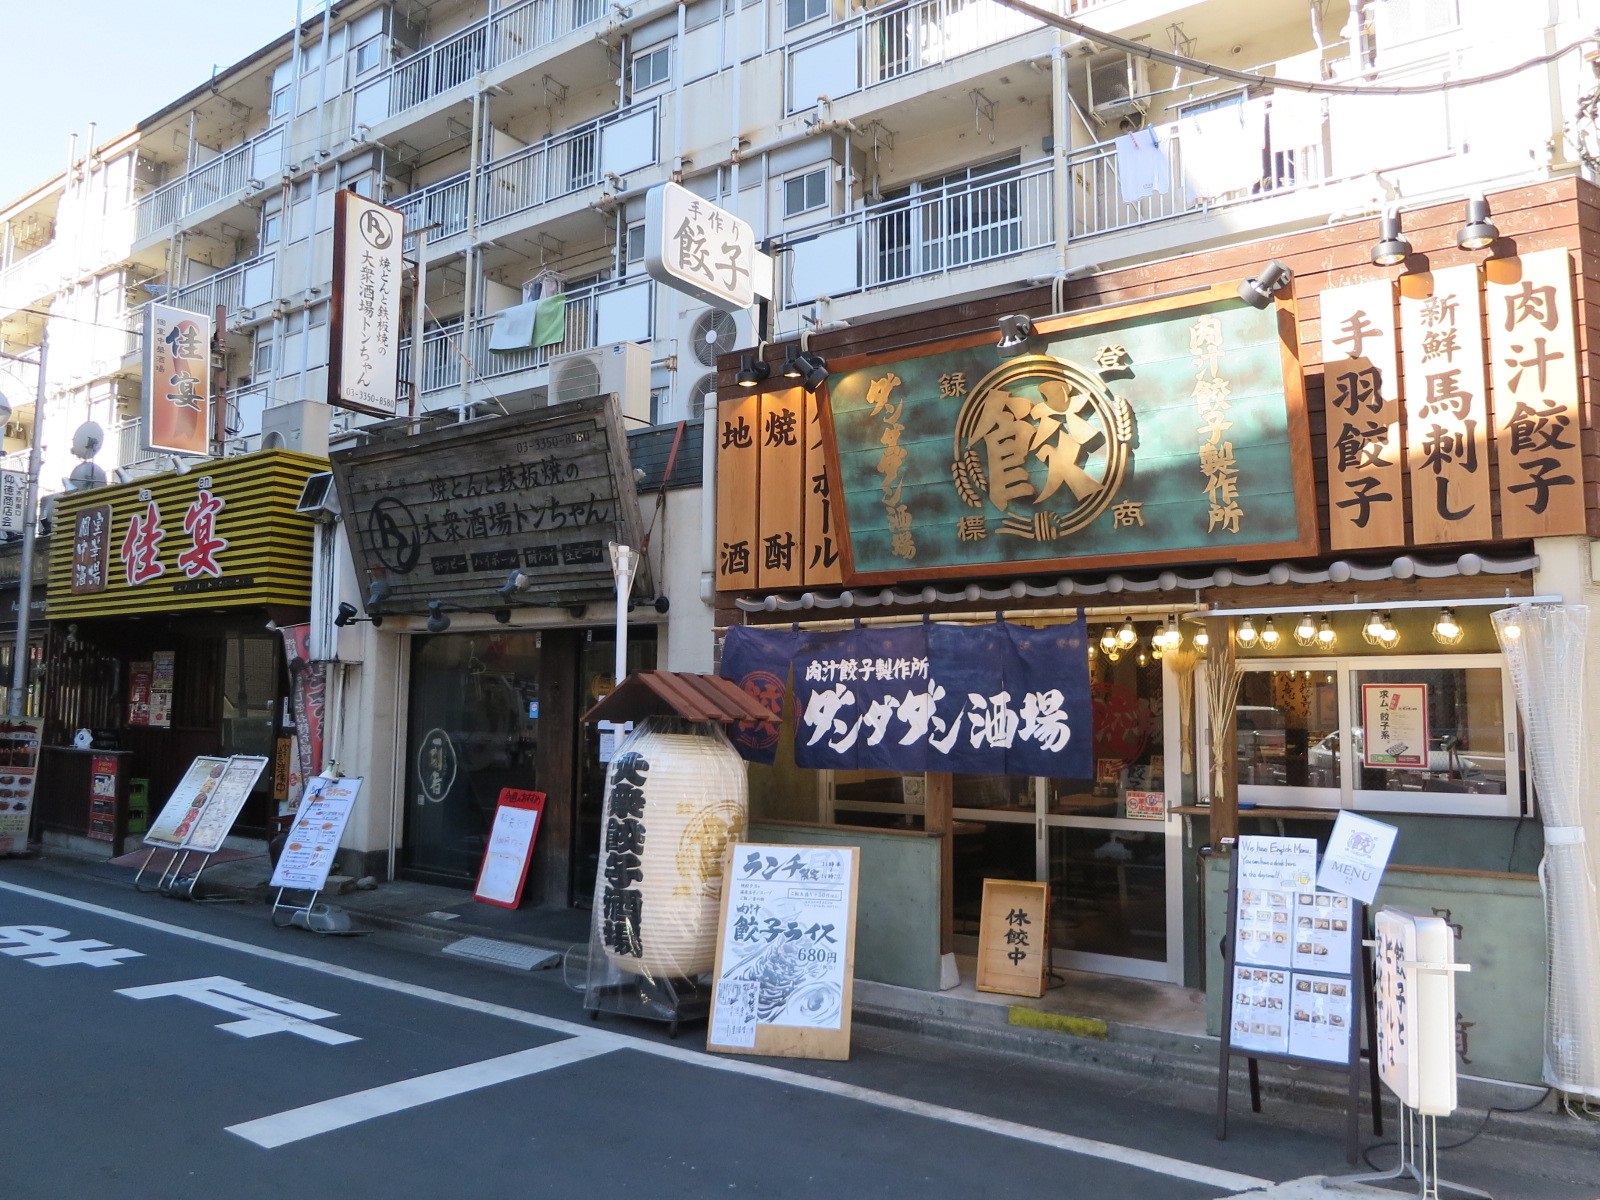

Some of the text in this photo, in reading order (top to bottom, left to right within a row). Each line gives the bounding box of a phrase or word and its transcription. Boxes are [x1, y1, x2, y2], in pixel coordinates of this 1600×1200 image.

[688, 201, 741, 242] 手作り
[673, 216, 750, 291] 餃子
[357, 250, 376, 388] 大衆酒場トンちゃん
[376, 255, 392, 357] 焼とんと鉄板焼の
[166, 325, 205, 412] 佳宴
[938, 372, 968, 400] 録
[1092, 345, 1130, 373] 登
[345, 387, 395, 409] 03-3350-8580
[1188, 314, 1245, 534] 肉汁餃子製作所
[1332, 310, 1393, 528] 手羽餃子
[1418, 293, 1478, 521] 新鮮馬刺し
[1503, 281, 1576, 514] 肉汁餃子
[516, 429, 591, 454] 03-3350-8580
[866, 373, 917, 560] ダンダダン酒場
[966, 380, 1104, 512] 餃
[199, 477, 211, 488] en
[428, 455, 580, 502] 焼とんと鉄板焼の
[721, 416, 753, 576] 地酒
[763, 408, 798, 572] 焼酎
[121, 490, 229, 586] 佳宴
[420, 493, 609, 546] 大衆酒場トンちゃん
[956, 515, 988, 541] 標
[1111, 500, 1146, 529] 商
[805, 656, 930, 682] 肉汁餃子製作所
[803, 678, 1072, 754] ダンダダン酒場
[1379, 689, 1391, 744] 求ム、餃子系。
[603, 751, 650, 958] 大衆餃子酒場
[1331, 860, 1373, 882] MENU
[733, 915, 838, 945] 餃子ライス
[736, 903, 761, 916] 肉汁
[1003, 908, 1031, 967] 休餃中
[798, 947, 837, 963] 680円
